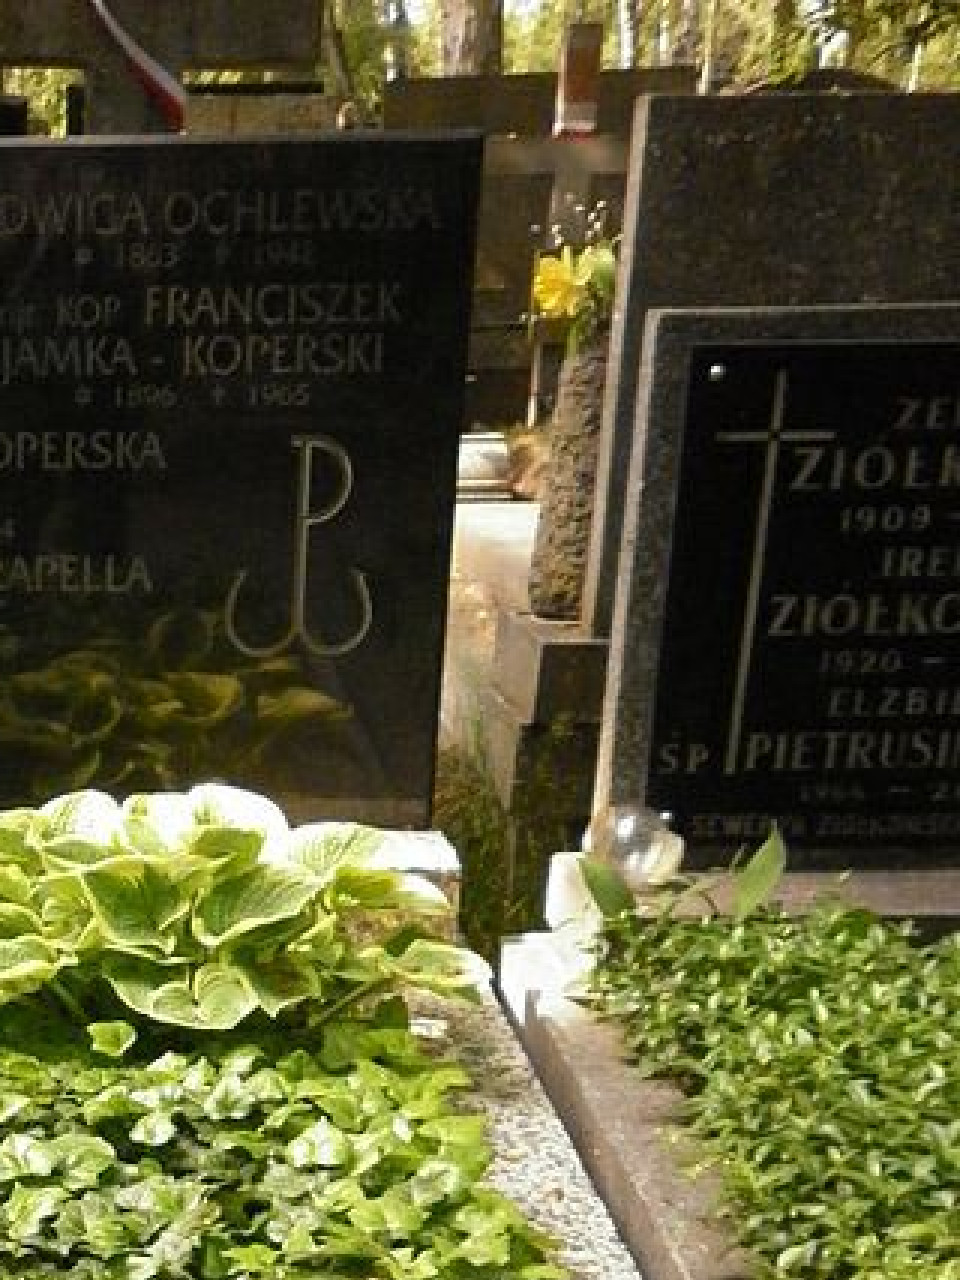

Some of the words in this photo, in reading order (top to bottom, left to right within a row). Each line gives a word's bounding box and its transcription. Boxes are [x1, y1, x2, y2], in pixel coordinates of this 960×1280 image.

[164, 188, 442, 235] OCHLEWSKA
[144, 282, 403, 327] FRANCISZEK
[1, 335, 138, 384] JAMKA
[181, 331, 385, 376] KOPERSKI
[893, 396, 960, 431] ZE
[841, 503, 933, 531] 1909
[881, 545, 960, 578] IRE
[818, 648, 903, 674] 1920
[744, 731, 960, 770] PIETRUSI
